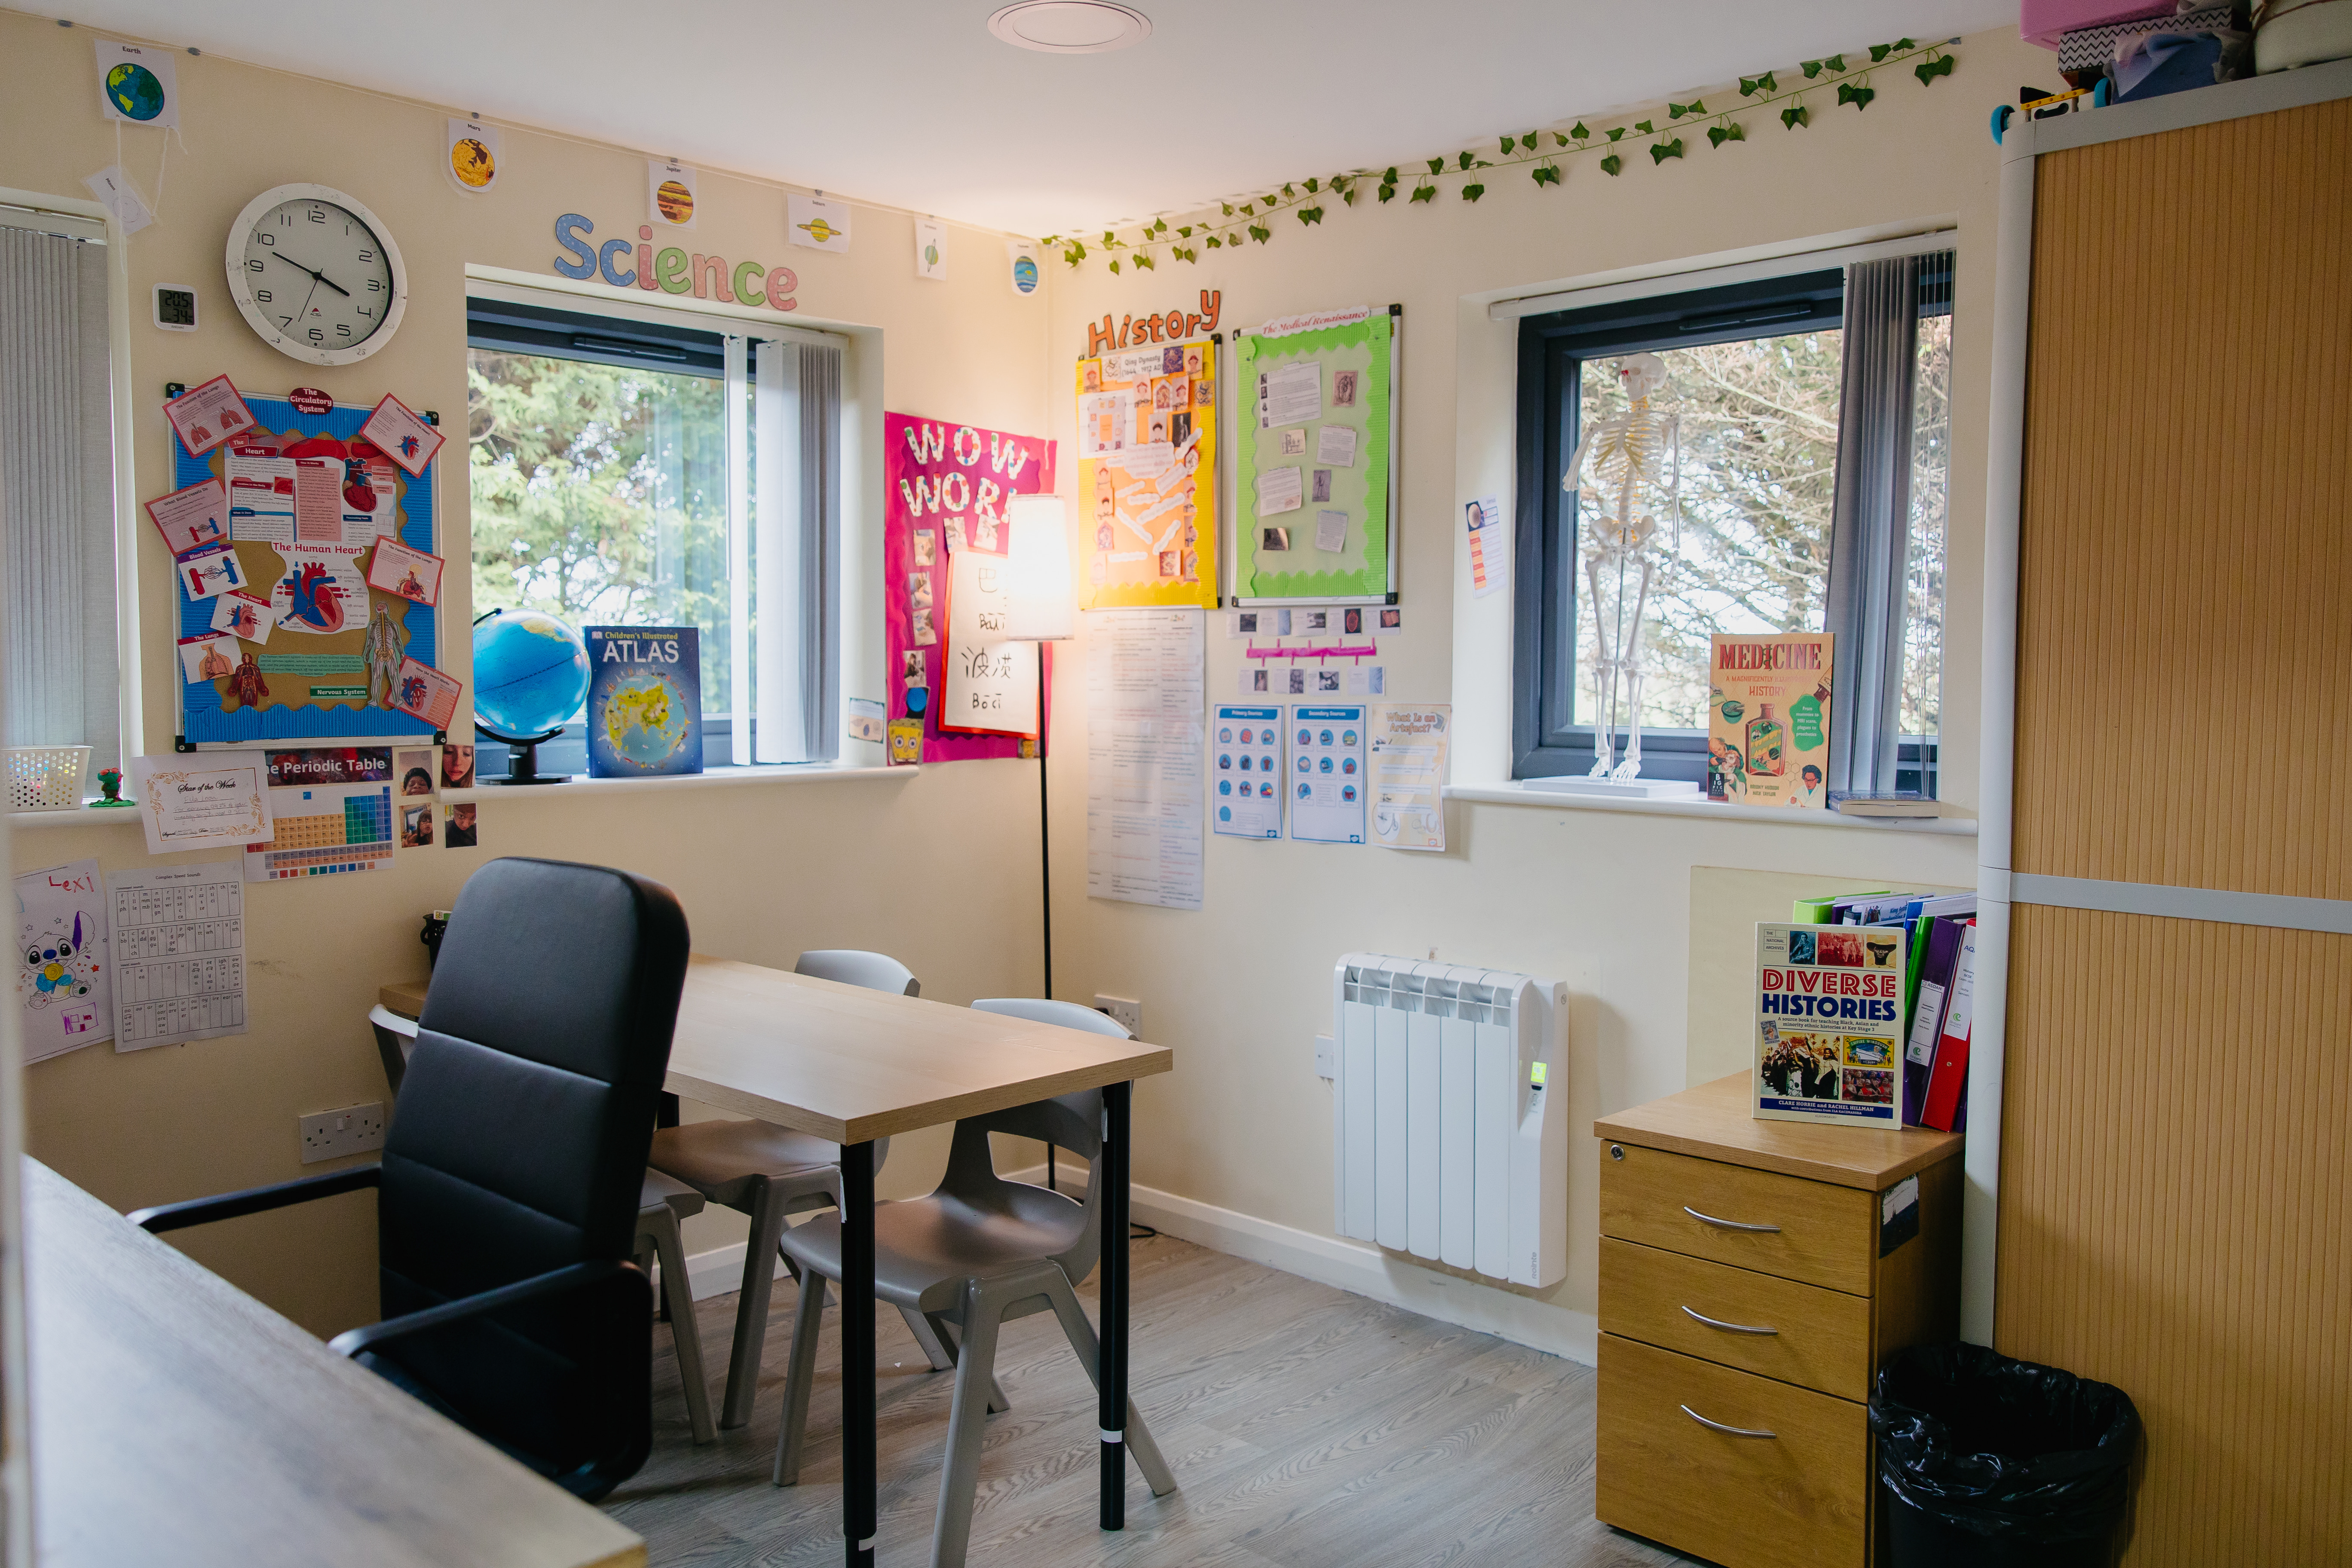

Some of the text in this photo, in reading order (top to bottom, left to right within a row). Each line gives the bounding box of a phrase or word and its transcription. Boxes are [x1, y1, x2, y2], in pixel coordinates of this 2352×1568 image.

[122, 46, 141, 54] Earth
[105, 178, 116, 191] Moon
[281, 214, 291, 227] 11
[308, 210, 325, 224] 12
[346, 225, 348, 236] 1
[257, 232, 274, 246] 10
[358, 250, 372, 262] 2
[554, 213, 798, 311] Science
[250, 260, 263, 272] 9
[368, 279, 380, 291] 3
[258, 290, 272, 302] 8
[173, 308, 188, 323] 34
[357, 306, 371, 318] 4
[279, 315, 293, 328] 7
[1088, 289, 1220, 358] History
[1263, 311, 1368, 334] The Medical Renaissance
[309, 328, 324, 340] 6
[337, 324, 351, 337] 5
[1139, 355, 1161, 364] Dynasty
[182, 396, 197, 406] Function
[290, 396, 332, 406] Circulatory
[298, 404, 325, 413] System
[401, 411, 413, 422] Function
[904, 421, 1029, 480] WOW
[273, 542, 363, 554] The Human Heart
[395, 547, 410, 555] Function
[248, 595, 262, 604] Heart
[603, 640, 679, 664] ATLAS
[1718, 643, 1821, 670] MEDICINE
[1749, 686, 1786, 696] HISTORY
[1386, 712, 1436, 723] What Is an
[1390, 723, 1431, 735] Artefact?
[284, 757, 385, 774] Periodic Table
[178, 783, 196, 794] Star
[197, 783, 205, 793] of
[216, 778, 236, 790] Week
[49, 872, 94, 893] Lexi
[1762, 969, 1896, 998] DIVERSE
[1762, 993, 1897, 1022] HISTORIES
[1866, 1038, 1888, 1049] WINDRUSH
